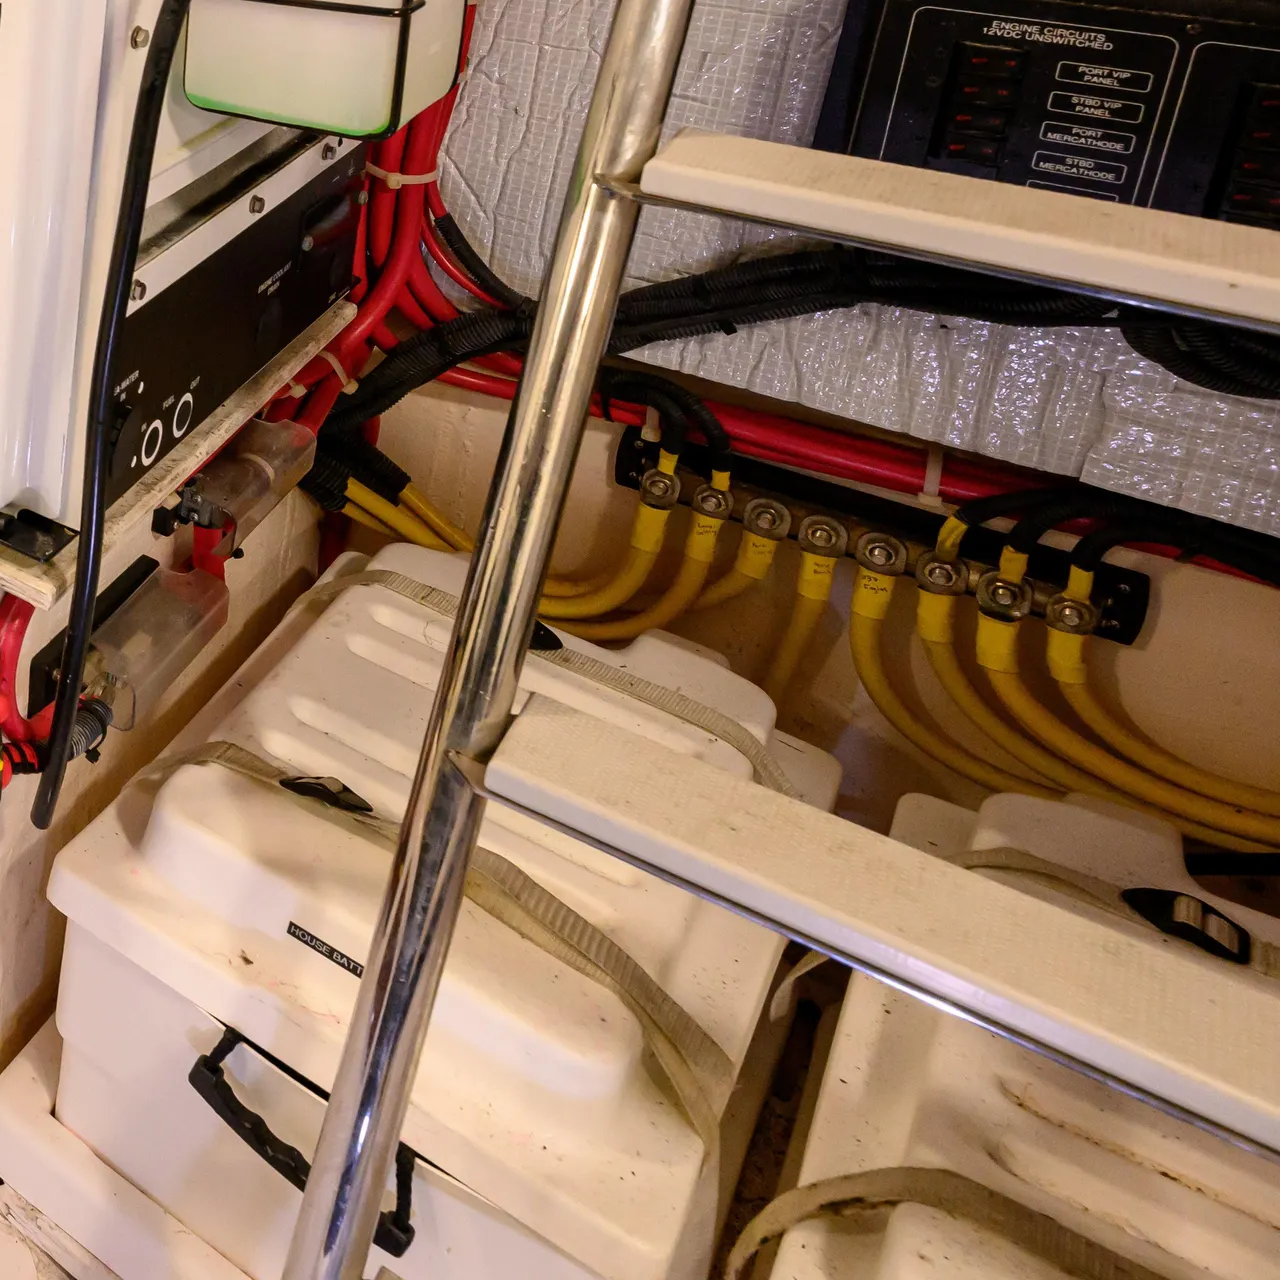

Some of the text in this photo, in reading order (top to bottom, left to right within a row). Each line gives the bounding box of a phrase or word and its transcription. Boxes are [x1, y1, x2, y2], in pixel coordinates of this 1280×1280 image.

[992, 21, 1107, 42] ENGINE CIRCUITS
[982, 27, 1113, 51] 12VDC UNSWITCHED
[1077, 66, 1131, 79] PORT VIP
[1083, 74, 1120, 87] PANEL
[1071, 96, 1123, 110] STBD VIP
[1075, 105, 1112, 118] PANEL
[1071, 127, 1103, 138] PORT
[1046, 132, 1125, 151] MERCATHODE
[1065, 157, 1095, 169] STBD
[1038, 161, 1116, 181] MERCATHODE
[290, 925, 363, 975] HOUSE BATT
